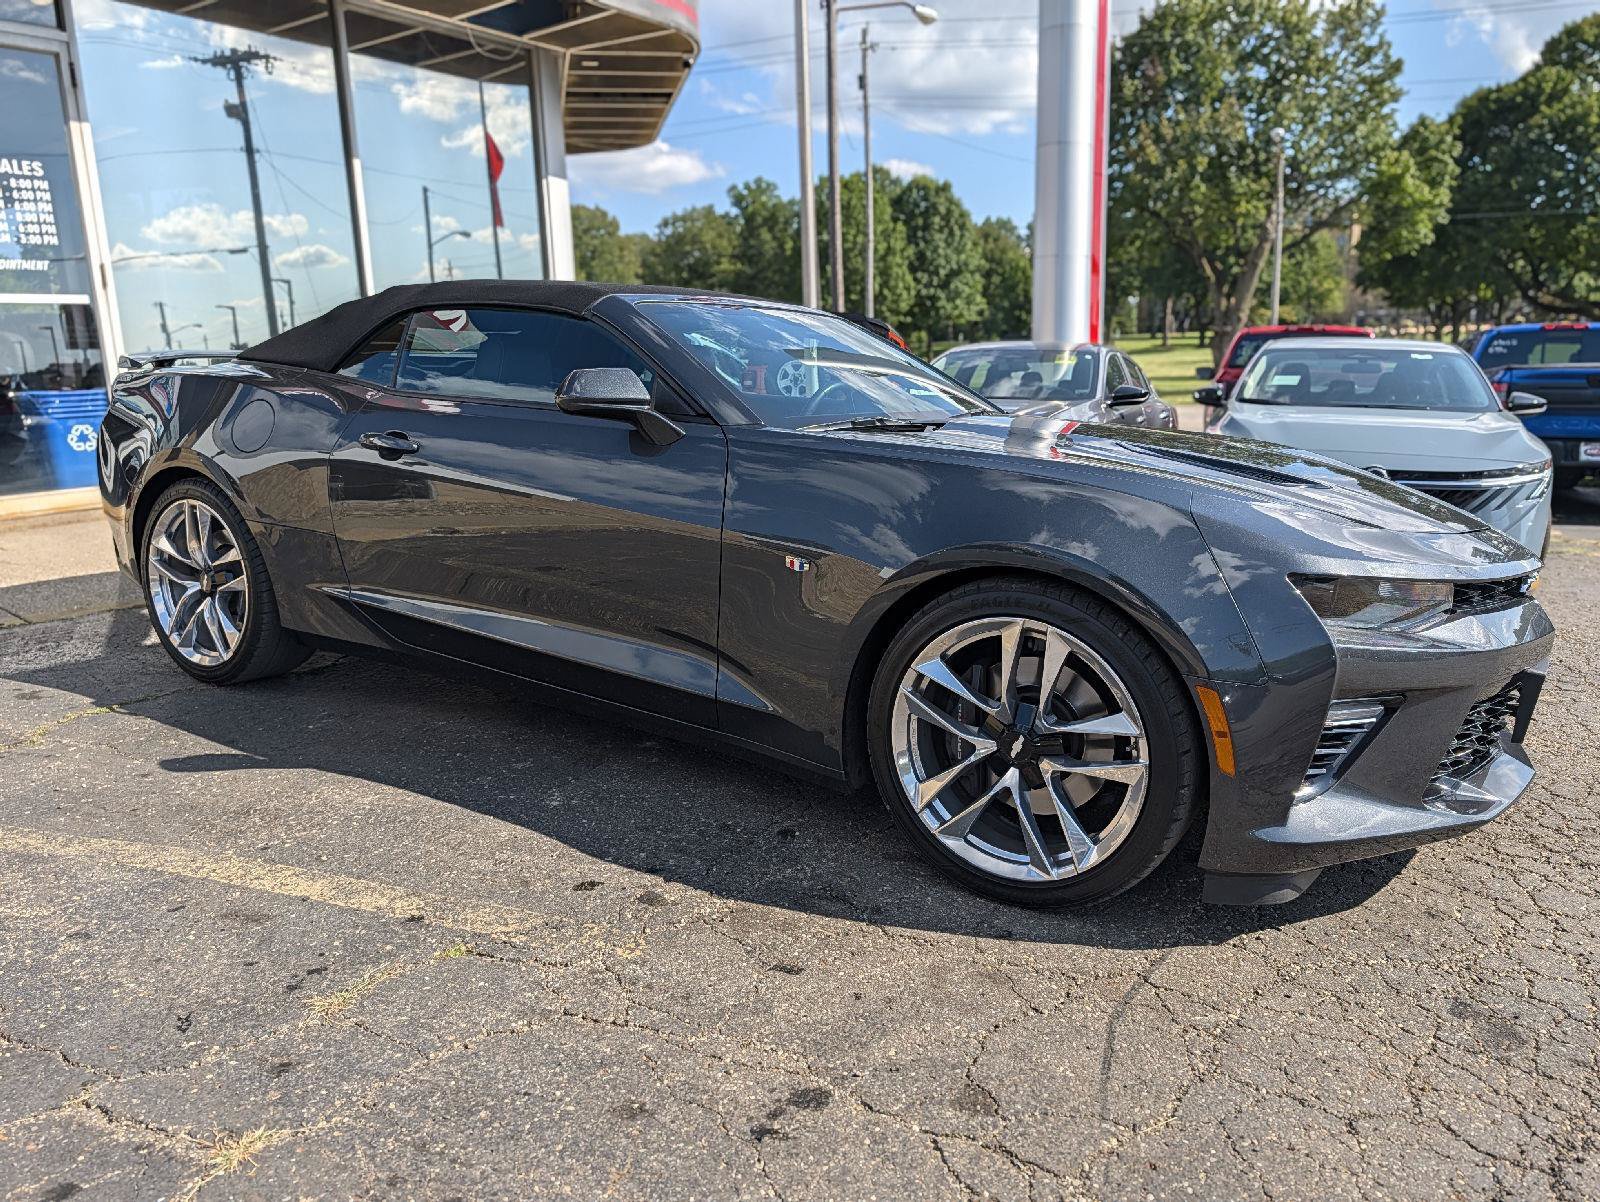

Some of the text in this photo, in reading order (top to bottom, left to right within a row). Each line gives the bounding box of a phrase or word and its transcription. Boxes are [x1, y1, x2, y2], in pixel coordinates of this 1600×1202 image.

[0, 158, 45, 177] ALES
[33, 179, 49, 191] PM
[35, 190, 52, 201] PM
[37, 201, 53, 213] PM
[38, 212, 55, 224] PM
[41, 223, 58, 235] PM
[43, 234, 59, 246] PM
